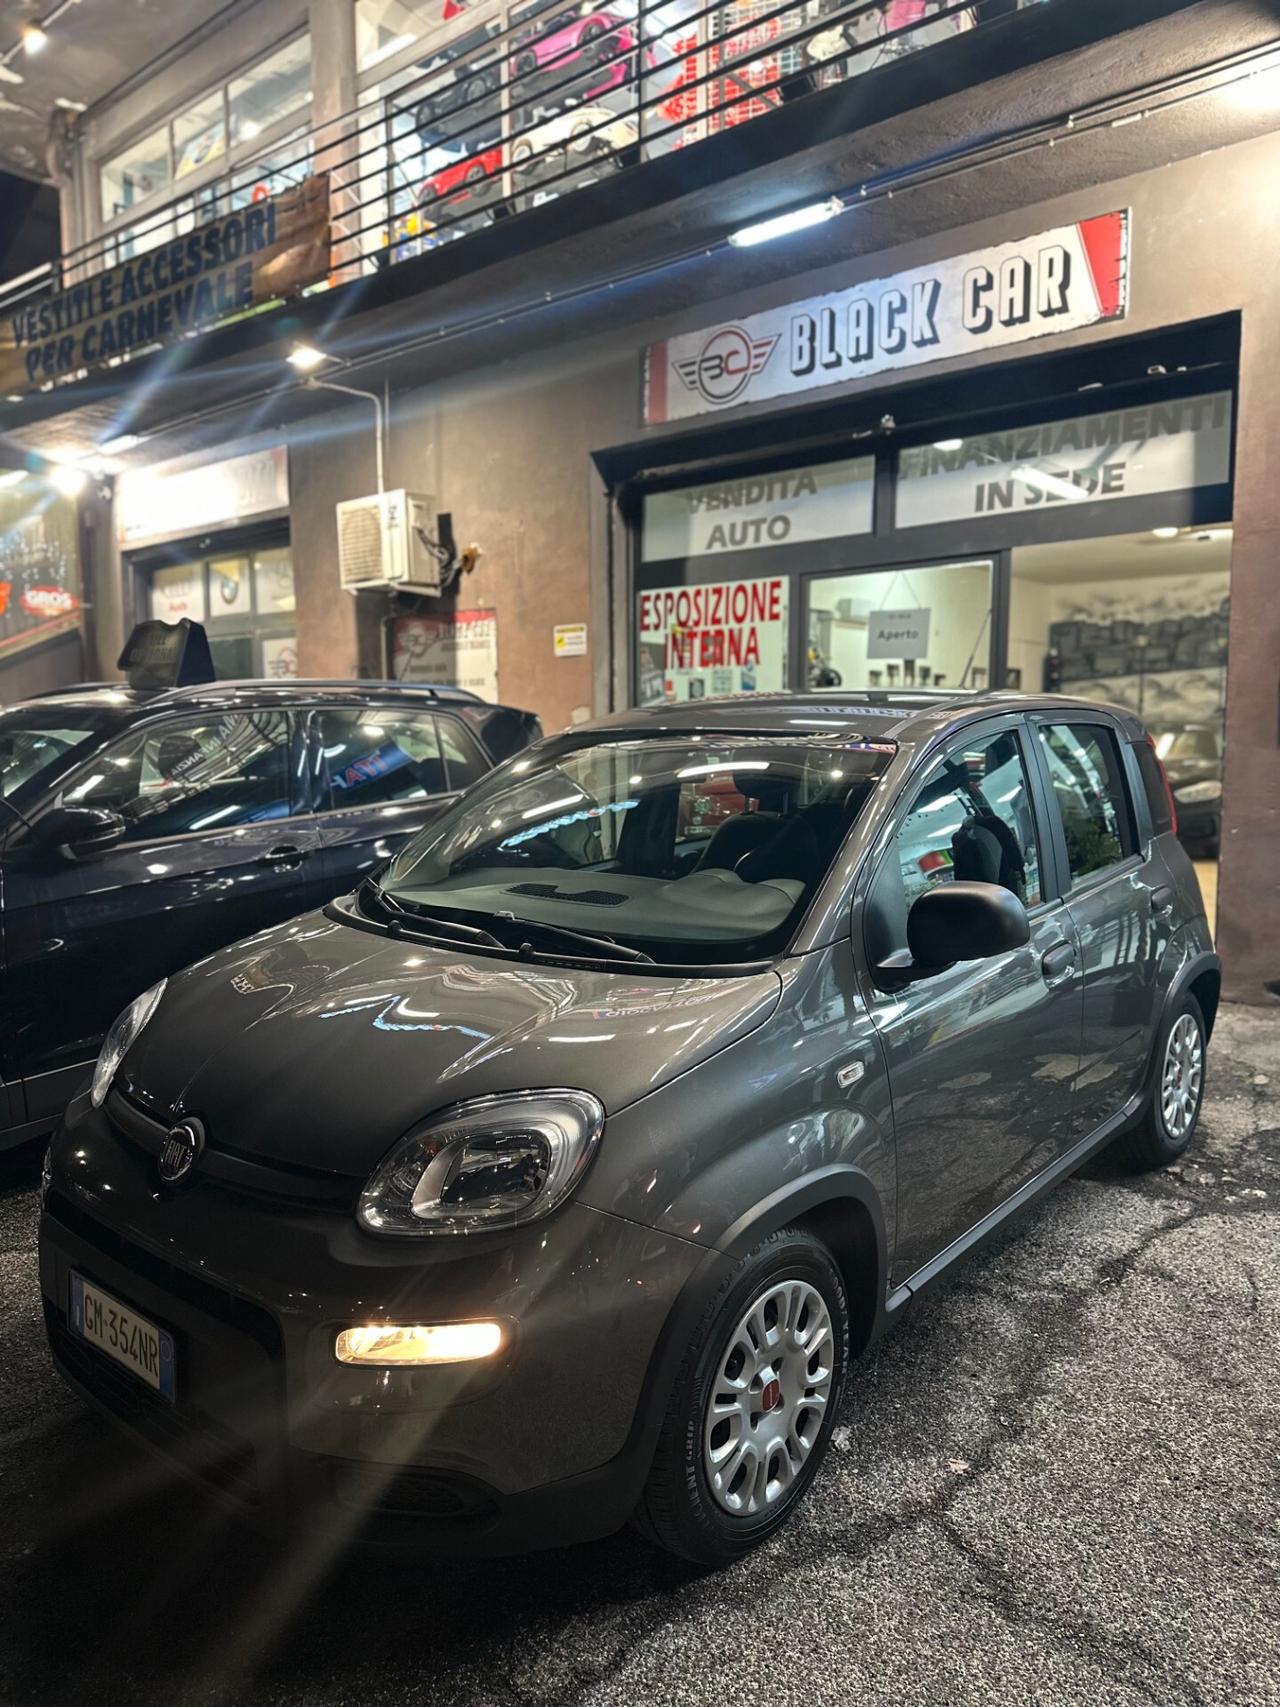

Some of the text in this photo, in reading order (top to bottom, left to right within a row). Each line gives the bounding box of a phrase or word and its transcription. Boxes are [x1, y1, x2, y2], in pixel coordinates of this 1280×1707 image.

[12, 201, 277, 349] VESTITI E ACCESSORI
[25, 261, 254, 382] PER CARNEVALE
[789, 244, 1071, 377] BLACK CAR
[900, 396, 1227, 480] FINANZIAMENTI
[686, 471, 818, 515] VENDITA
[974, 478, 1015, 512] IN
[705, 515, 791, 550] AUTO
[640, 579, 782, 631] ESPOSIZIONE
[664, 627, 761, 670] INTERNA
[878, 629, 919, 642] Aperto
[164, 1139, 188, 1169] FIAT
